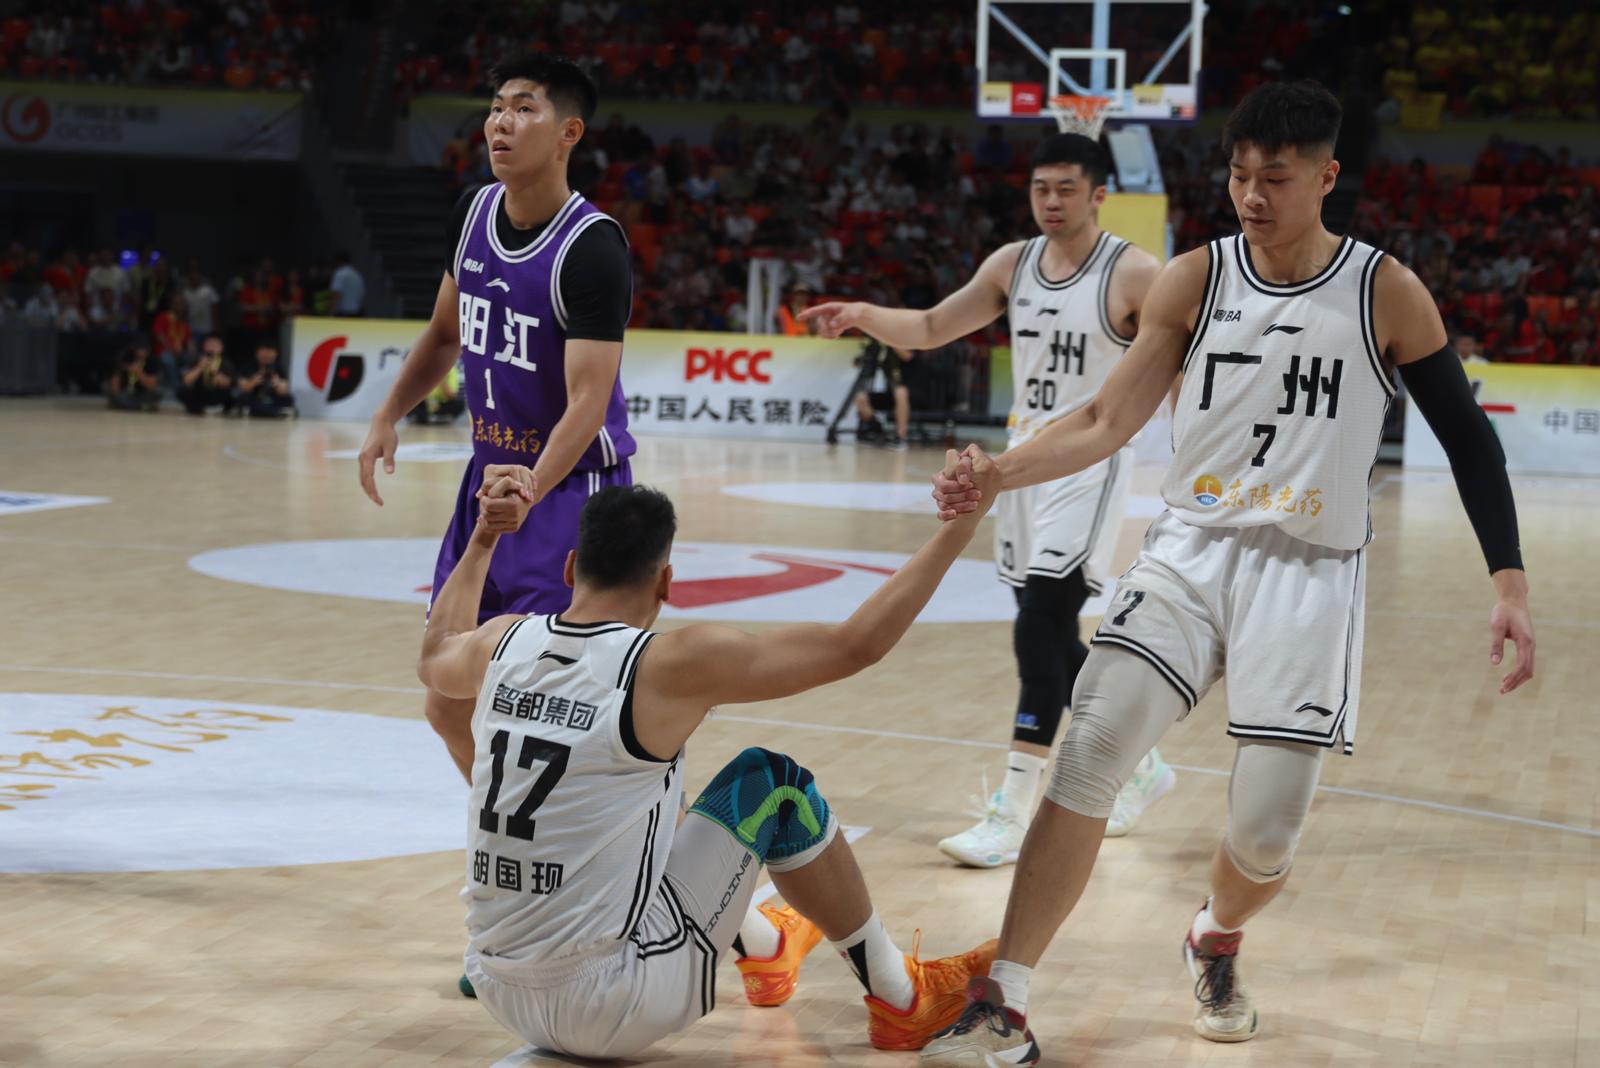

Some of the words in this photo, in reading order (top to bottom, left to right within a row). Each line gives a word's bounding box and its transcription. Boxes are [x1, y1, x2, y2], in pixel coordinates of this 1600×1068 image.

[684, 346, 773, 385] PICC
[1199, 352, 1343, 419] 广州
[485, 368, 495, 410] 1
[625, 392, 830, 426] 中国人民保险
[1026, 377, 1056, 411] 30
[1251, 424, 1277, 467] 7
[1112, 590, 1146, 626] 7
[492, 683, 599, 732] 智都集团
[479, 729, 572, 841] 17
[474, 849, 564, 895] 胡国现
[704, 851, 752, 933] INDING
